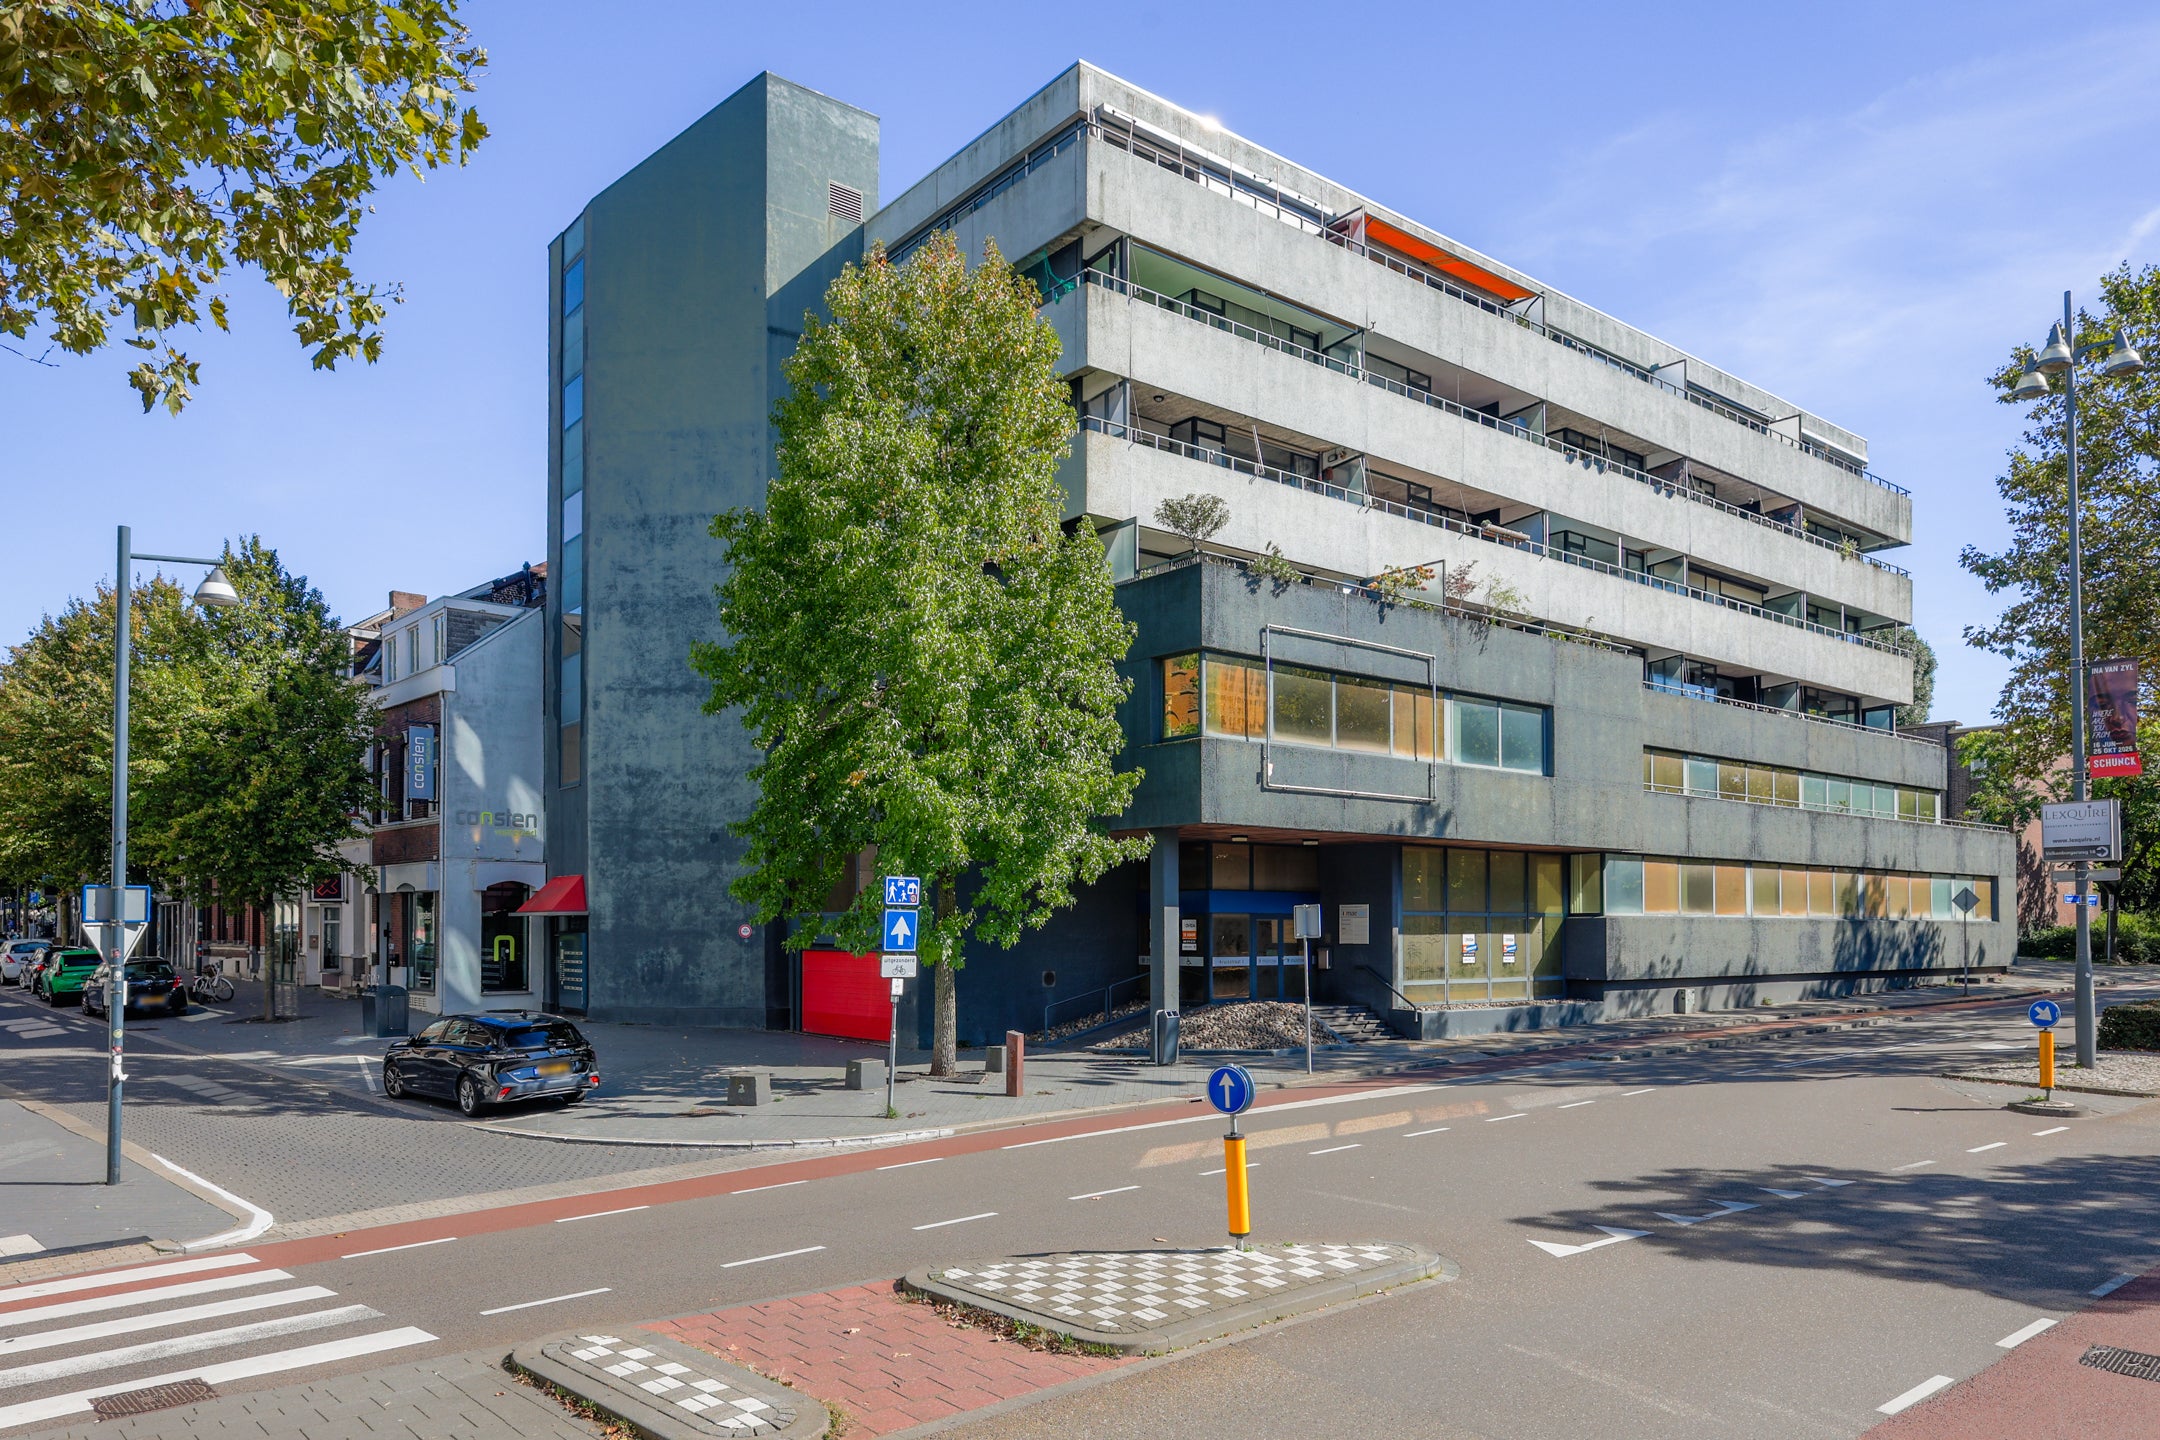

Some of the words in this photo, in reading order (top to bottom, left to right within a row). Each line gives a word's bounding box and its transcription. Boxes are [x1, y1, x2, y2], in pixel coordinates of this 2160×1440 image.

[2105, 665, 2118, 673] VAN
[2092, 731, 2111, 739] FROM
[412, 736, 424, 789] consten
[2093, 757, 2137, 768] SCHUNCK
[453, 808, 538, 829] consten
